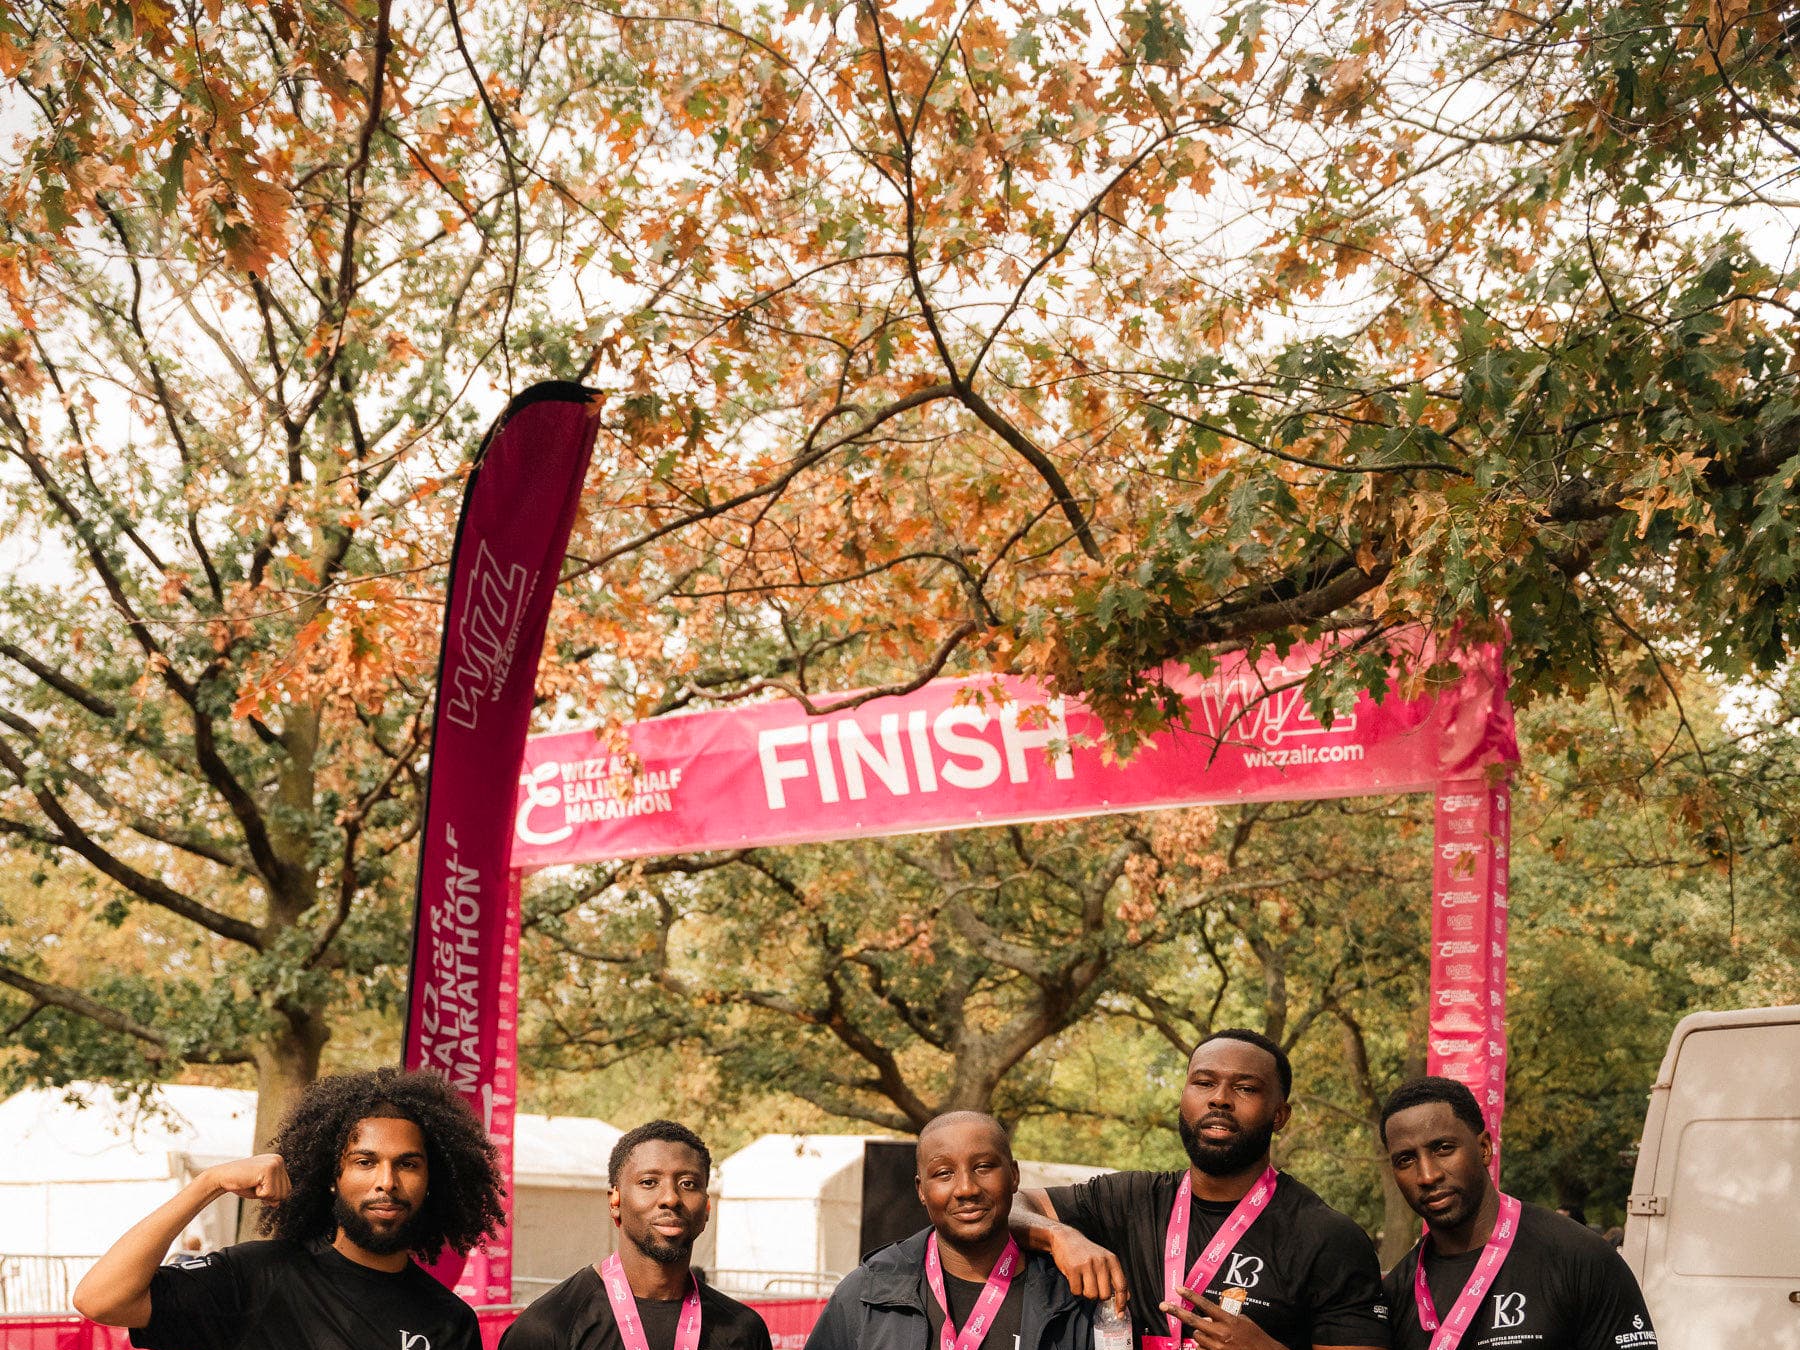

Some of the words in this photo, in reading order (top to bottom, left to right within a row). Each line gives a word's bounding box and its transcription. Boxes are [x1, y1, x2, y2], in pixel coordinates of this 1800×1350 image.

[561, 758, 606, 782] WIZZ
[563, 777, 632, 803] EALIN
[634, 768, 682, 795] HALF
[758, 693, 1075, 810] FINISH
[1243, 744, 1364, 768] wizzair.com
[565, 792, 672, 824] MARATHON
[442, 823, 459, 931] HALF
[434, 940, 460, 1084] EALING
[455, 866, 481, 1093] MARATHON
